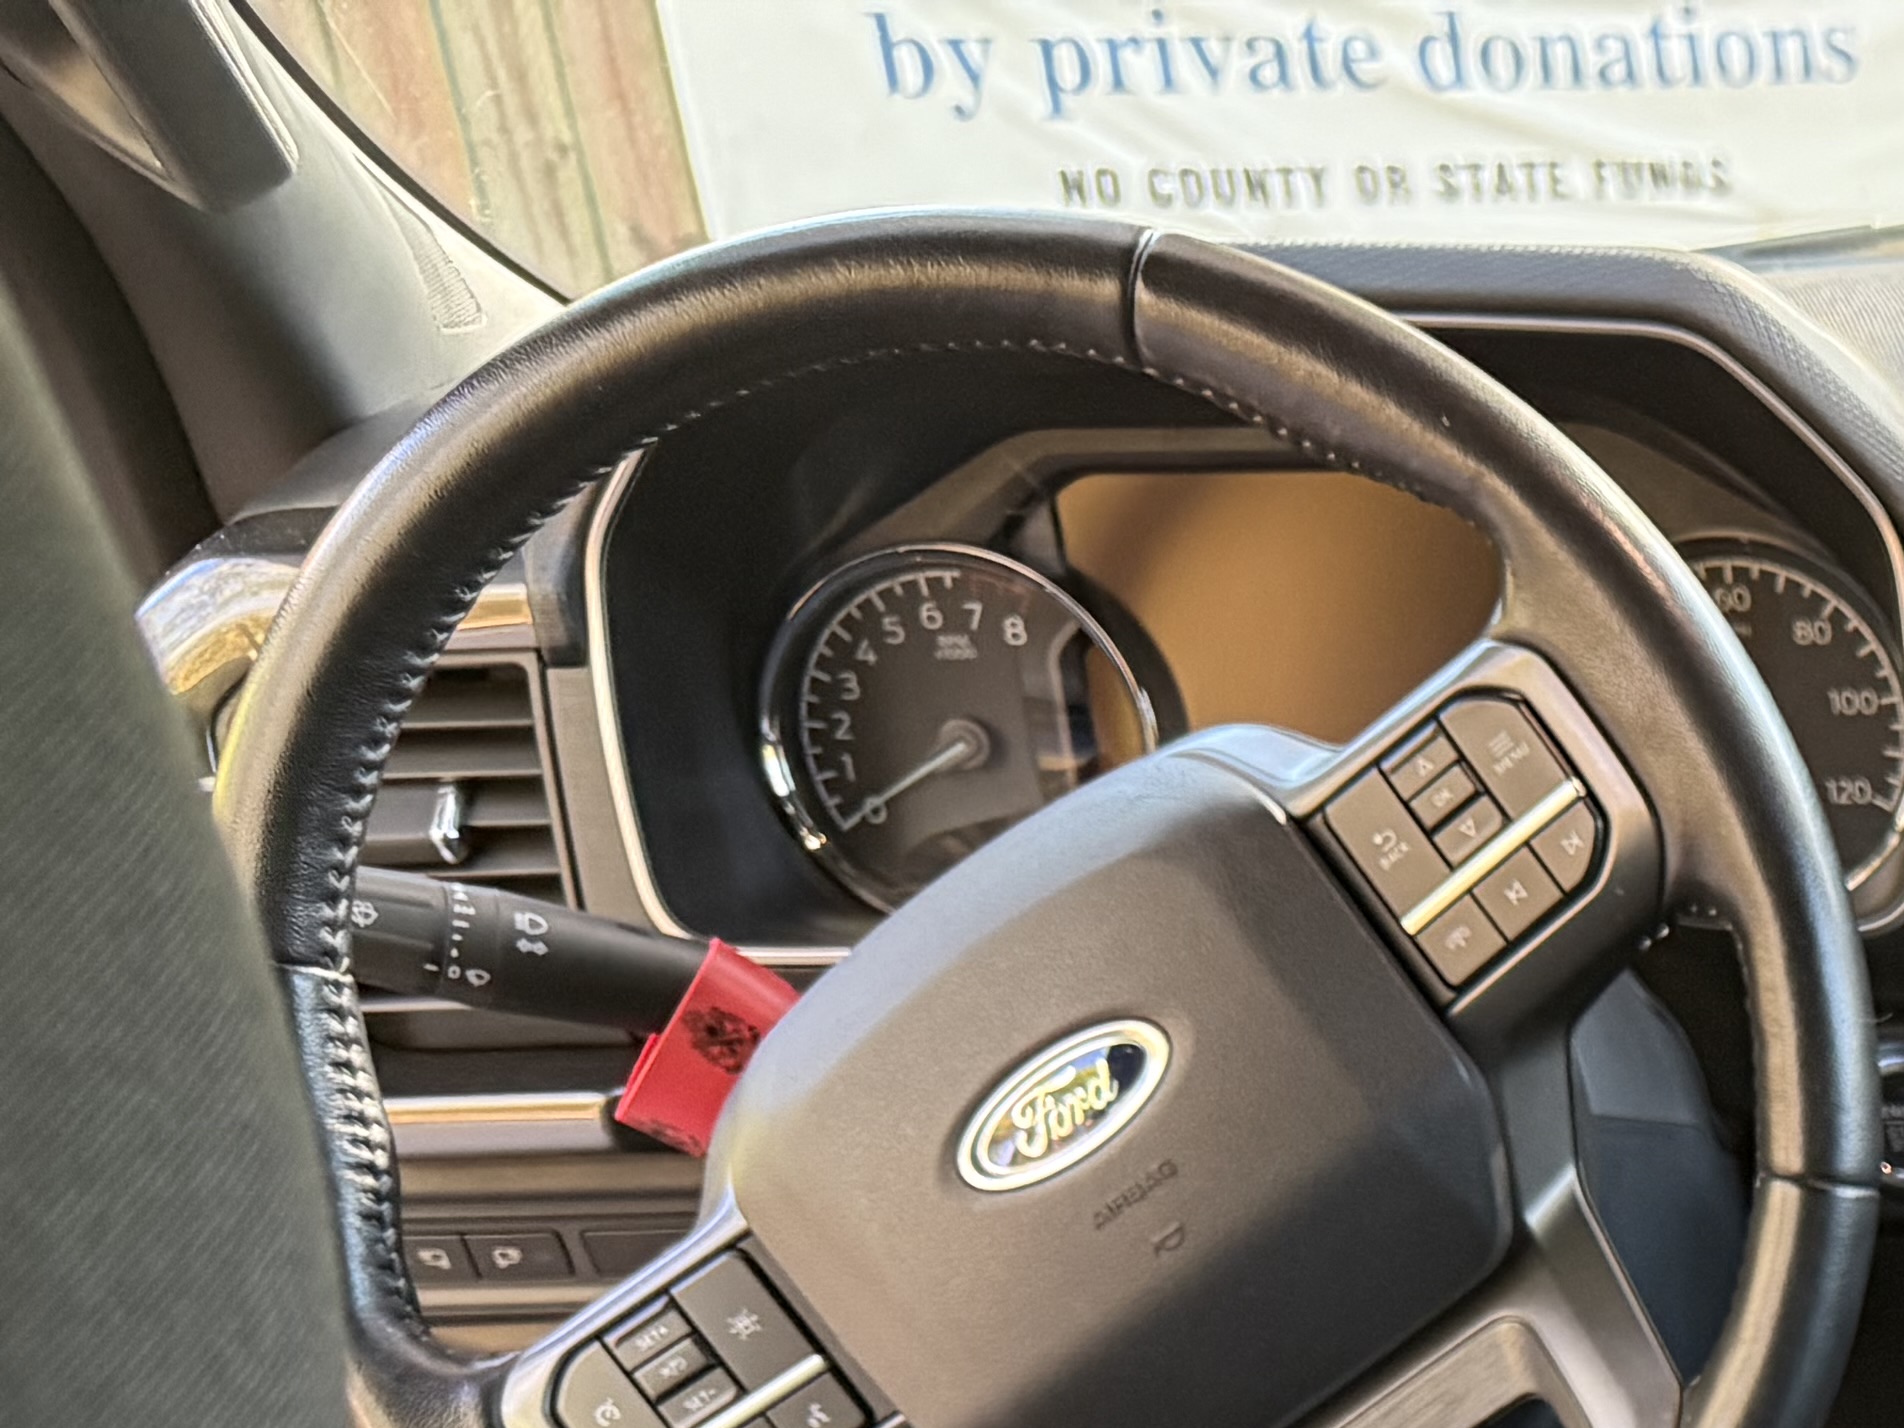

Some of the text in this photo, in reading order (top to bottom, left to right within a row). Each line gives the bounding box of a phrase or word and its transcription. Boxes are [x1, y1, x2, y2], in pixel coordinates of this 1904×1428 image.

[871, 2, 1862, 121] by private donations
[1058, 156, 1732, 209] NO COUNTY OR STATE FUNDS
[881, 616, 906, 644] 5
[920, 602, 944, 630] 6
[962, 603, 984, 631] 7
[1003, 615, 1028, 646] 8
[1792, 619, 1832, 646] 80
[856, 639, 878, 665] 4
[838, 673, 862, 701] 3
[1827, 689, 1878, 716] 100
[832, 711, 855, 741] 2
[840, 752, 856, 781] 1
[1825, 778, 1872, 805] 120
[1011, 1058, 1120, 1158] Ford
[1092, 1158, 1178, 1230] AIRBAG
